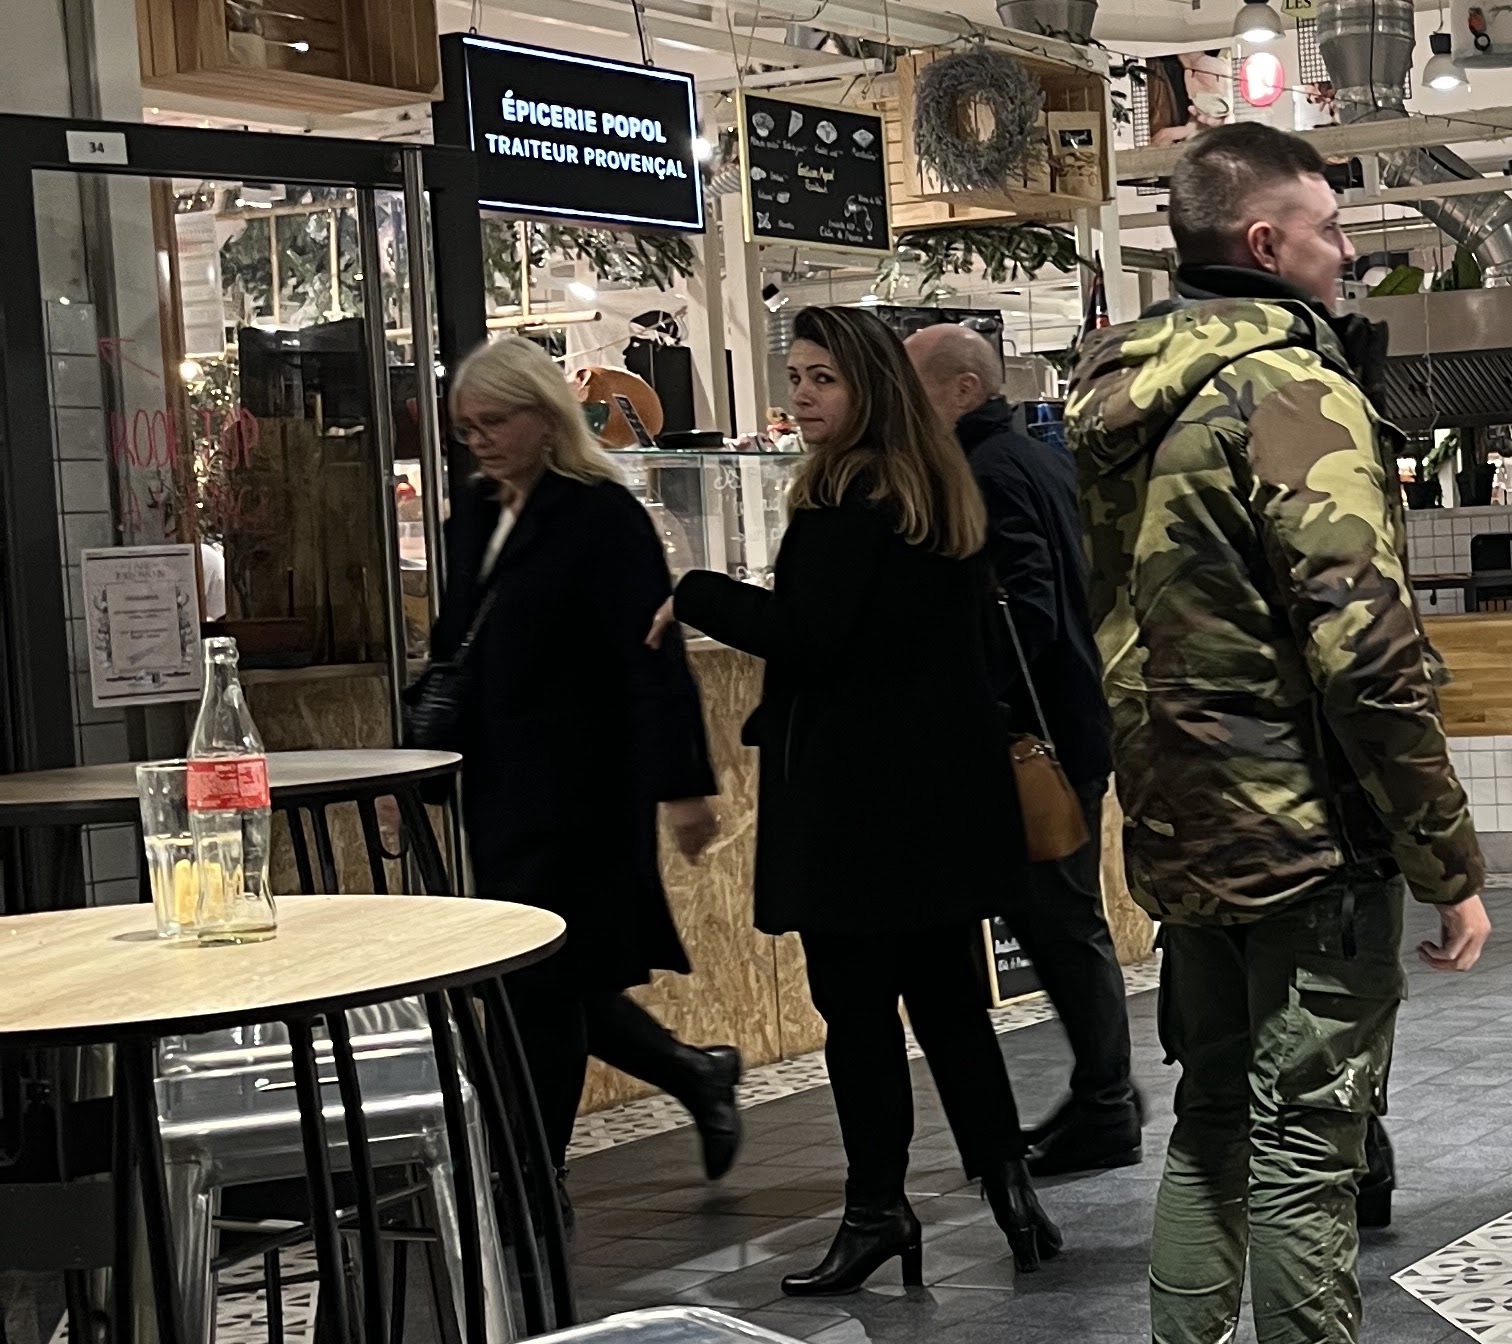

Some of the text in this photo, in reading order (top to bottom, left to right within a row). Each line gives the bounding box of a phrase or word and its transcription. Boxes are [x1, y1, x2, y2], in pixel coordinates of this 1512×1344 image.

[501, 89, 667, 144] ÉPICERIE POPOL
[89, 141, 105, 154] 34
[484, 133, 687, 180] TRAITEUR PROVENÇAL
